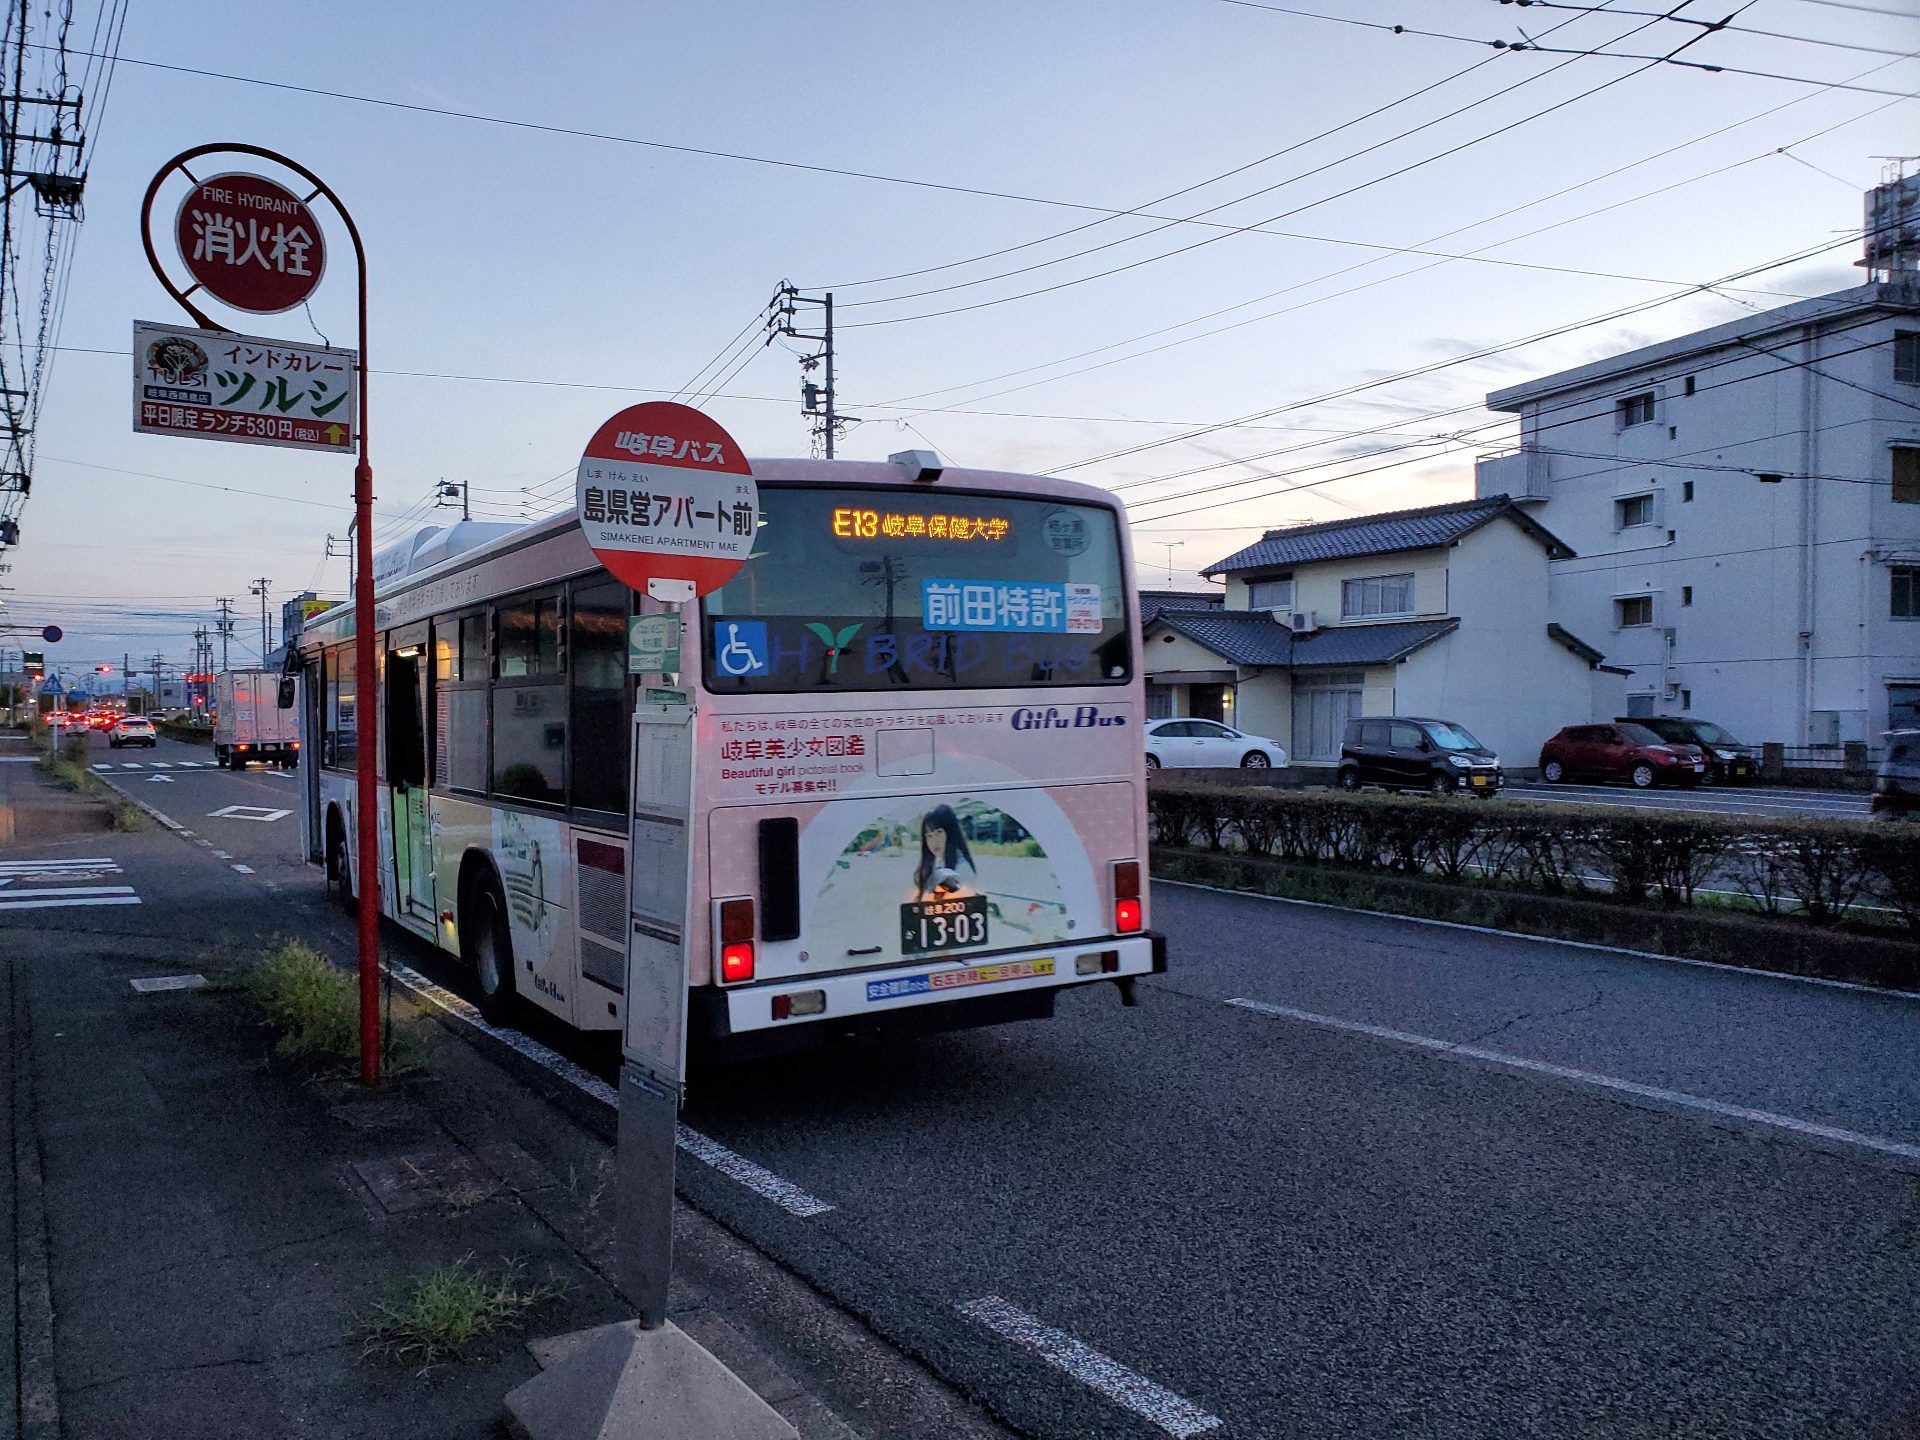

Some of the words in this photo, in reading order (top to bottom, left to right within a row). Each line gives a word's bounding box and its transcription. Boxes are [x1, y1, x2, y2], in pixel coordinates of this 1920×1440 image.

[203, 186, 233, 205] FIRE
[237, 191, 299, 215] HYDRANT
[192, 208, 313, 277] 消火栓
[224, 345, 343, 373] インドカレー
[148, 367, 208, 388] TULSI
[213, 369, 348, 418] ツルシ
[143, 404, 199, 429] 平日限定
[615, 431, 725, 465] 岐阜バス
[587, 468, 602, 479] しま
[608, 471, 626, 482] けん
[632, 473, 649, 482] えい
[735, 485, 750, 495] まえ
[583, 486, 753, 537] 島県営アパート前
[833, 509, 878, 537] E13
[881, 512, 1010, 541] 岐阜保健大学
[600, 531, 654, 545] SIMAKENEI
[657, 536, 715, 549] APARTMENT
[718, 542, 738, 552] MAE
[926, 583, 1063, 628] 前田特許
[772, 623, 987, 675] HYBRID
[1006, 634, 1090, 673] Bus
[1011, 708, 1070, 731] Gifu
[1073, 706, 1127, 728] Bus
[721, 734, 866, 761] 岐阜美少女図鑑
[721, 766, 774, 779] Beautiful
[777, 766, 796, 780] girl
[840, 763, 864, 774] book
[755, 779, 837, 795] モデル募集中!!
[920, 912, 985, 949] 13-03
